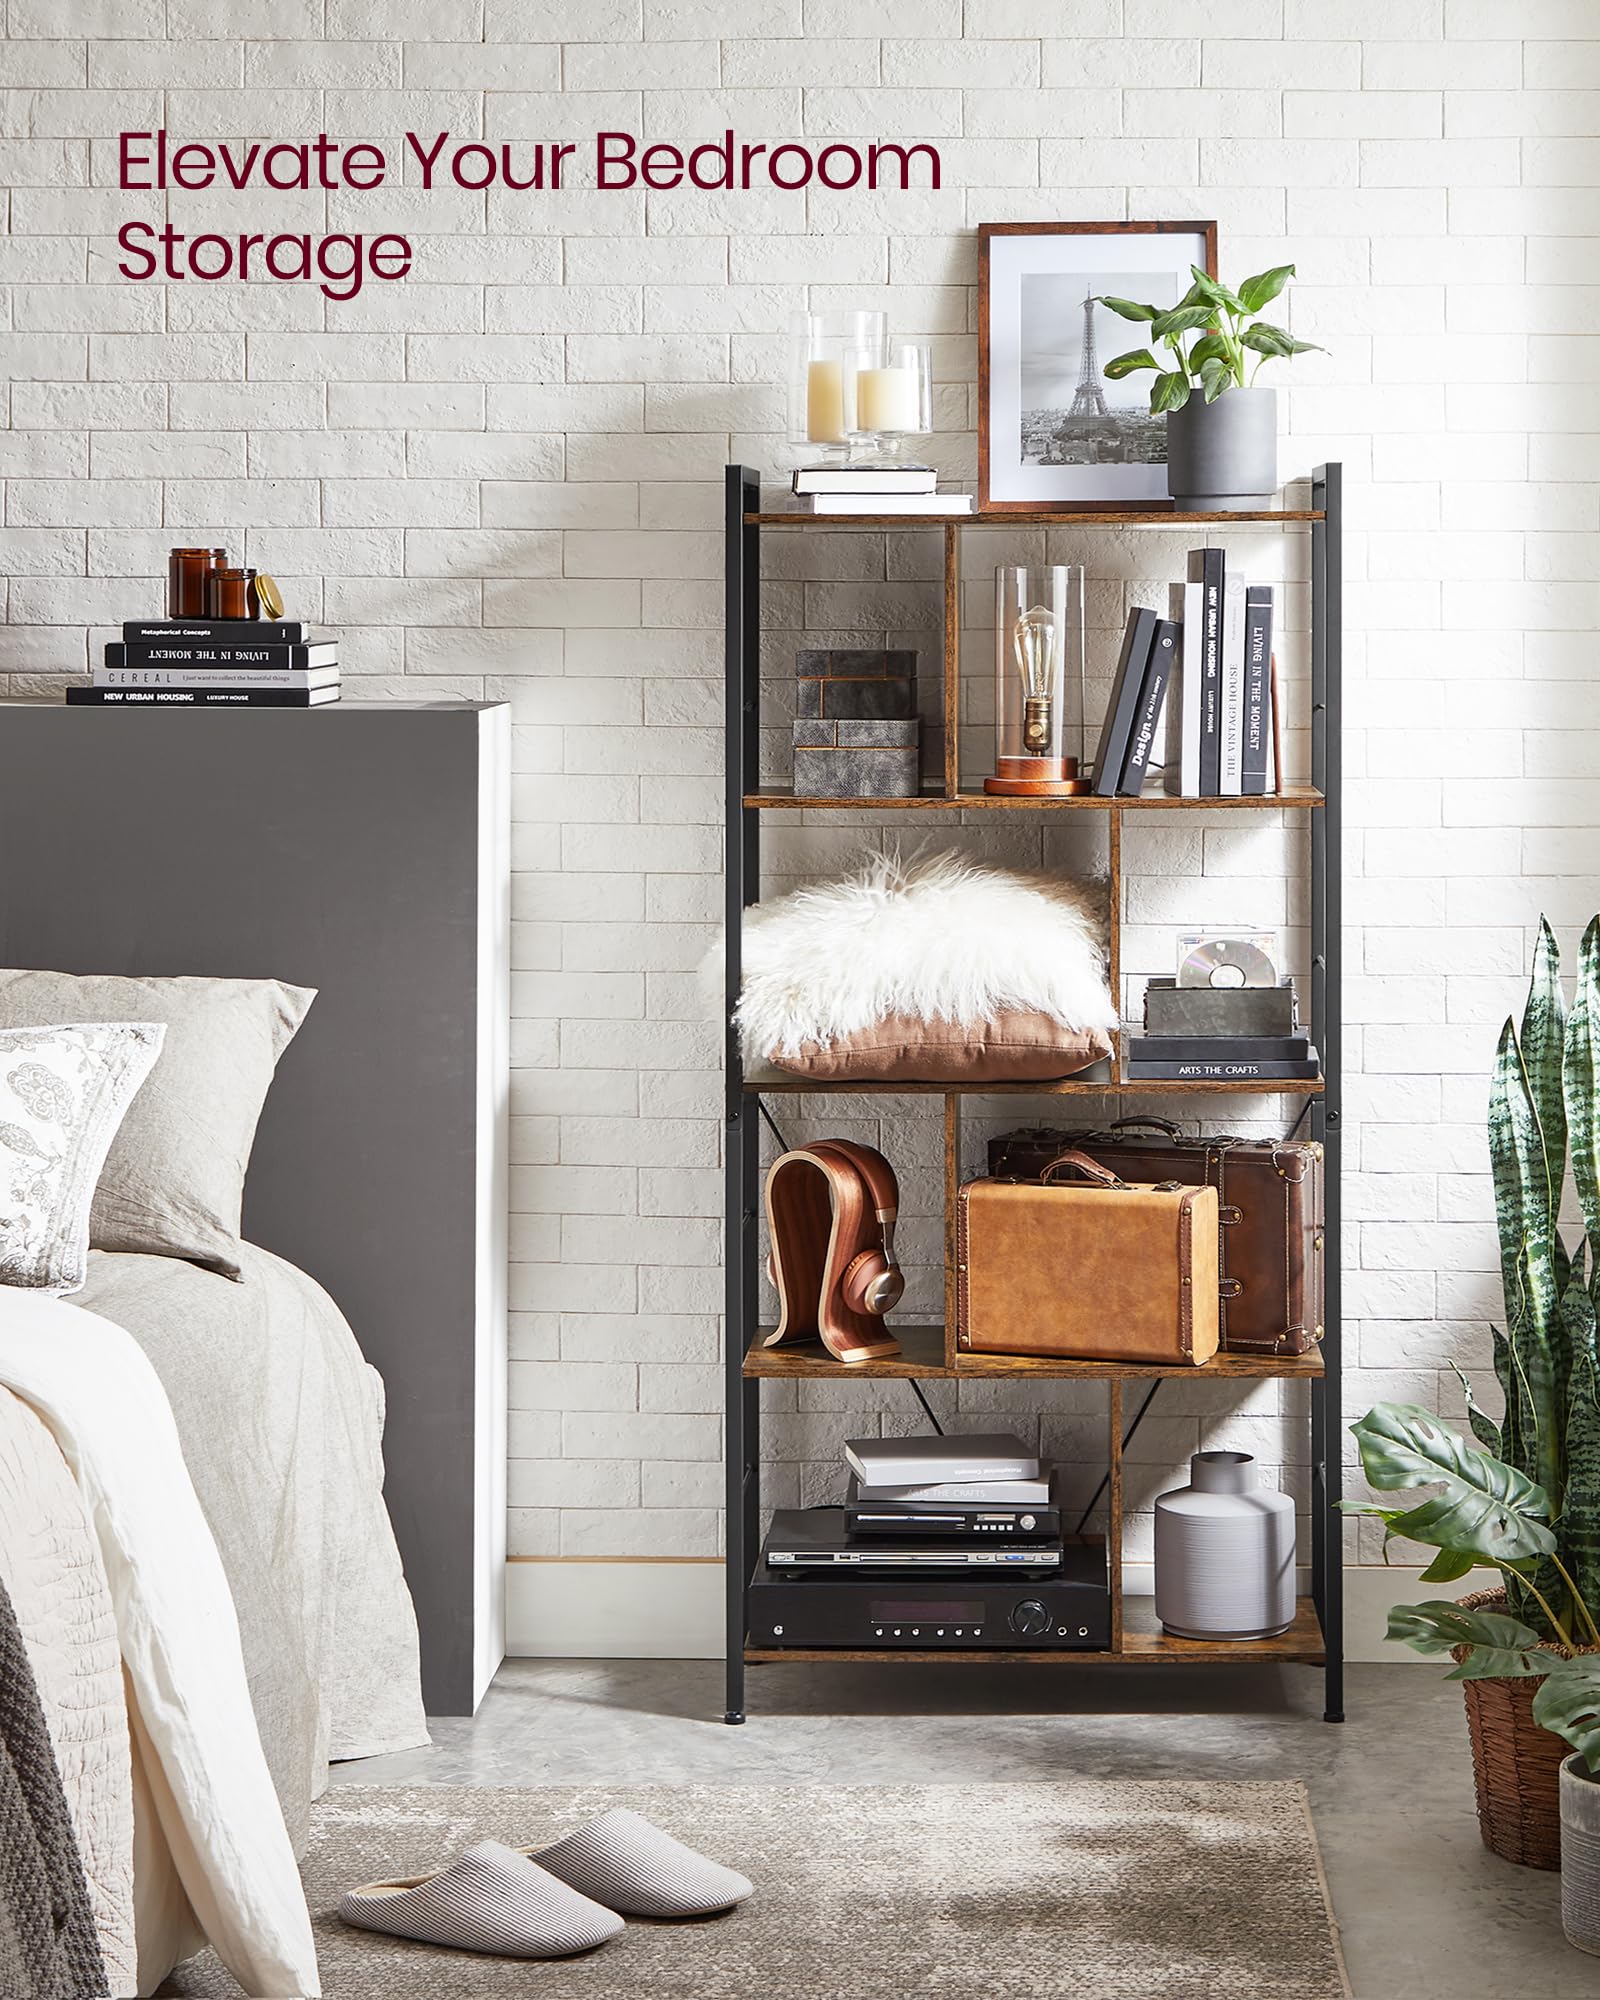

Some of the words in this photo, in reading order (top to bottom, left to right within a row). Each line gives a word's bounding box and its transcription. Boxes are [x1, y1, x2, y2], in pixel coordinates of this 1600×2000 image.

[1208, 586, 1217, 607] NEW
[1207, 608, 1217, 638] URBAN
[140, 629, 181, 637] Metaphorical
[182, 629, 211, 637] Concepts
[1252, 627, 1264, 662] LIVING
[148, 649, 192, 660] MOMENT
[195, 650, 217, 660] THE
[220, 651, 231, 661] IN
[235, 651, 270, 661] LIVING
[1207, 640, 1217, 678] HOUSING
[108, 672, 172, 684] CEREAL
[1252, 666, 1262, 677] IN
[1228, 663, 1238, 702] HOUSE
[103, 692, 124, 701] NEW
[125, 692, 155, 701] URBAN
[156, 692, 194, 701] HOUSING
[1251, 680, 1262, 702] THE
[1227, 703, 1237, 752] VINTAGE
[1249, 705, 1261, 751] MOMENT
[1131, 721, 1152, 767] Design
[1227, 755, 1236, 777] THE
[1178, 1065, 1202, 1075] ARTS
[1204, 1065, 1223, 1075] THE
[1225, 1065, 1259, 1075] CRAFTS
[933, 1488, 949, 1498] THE
